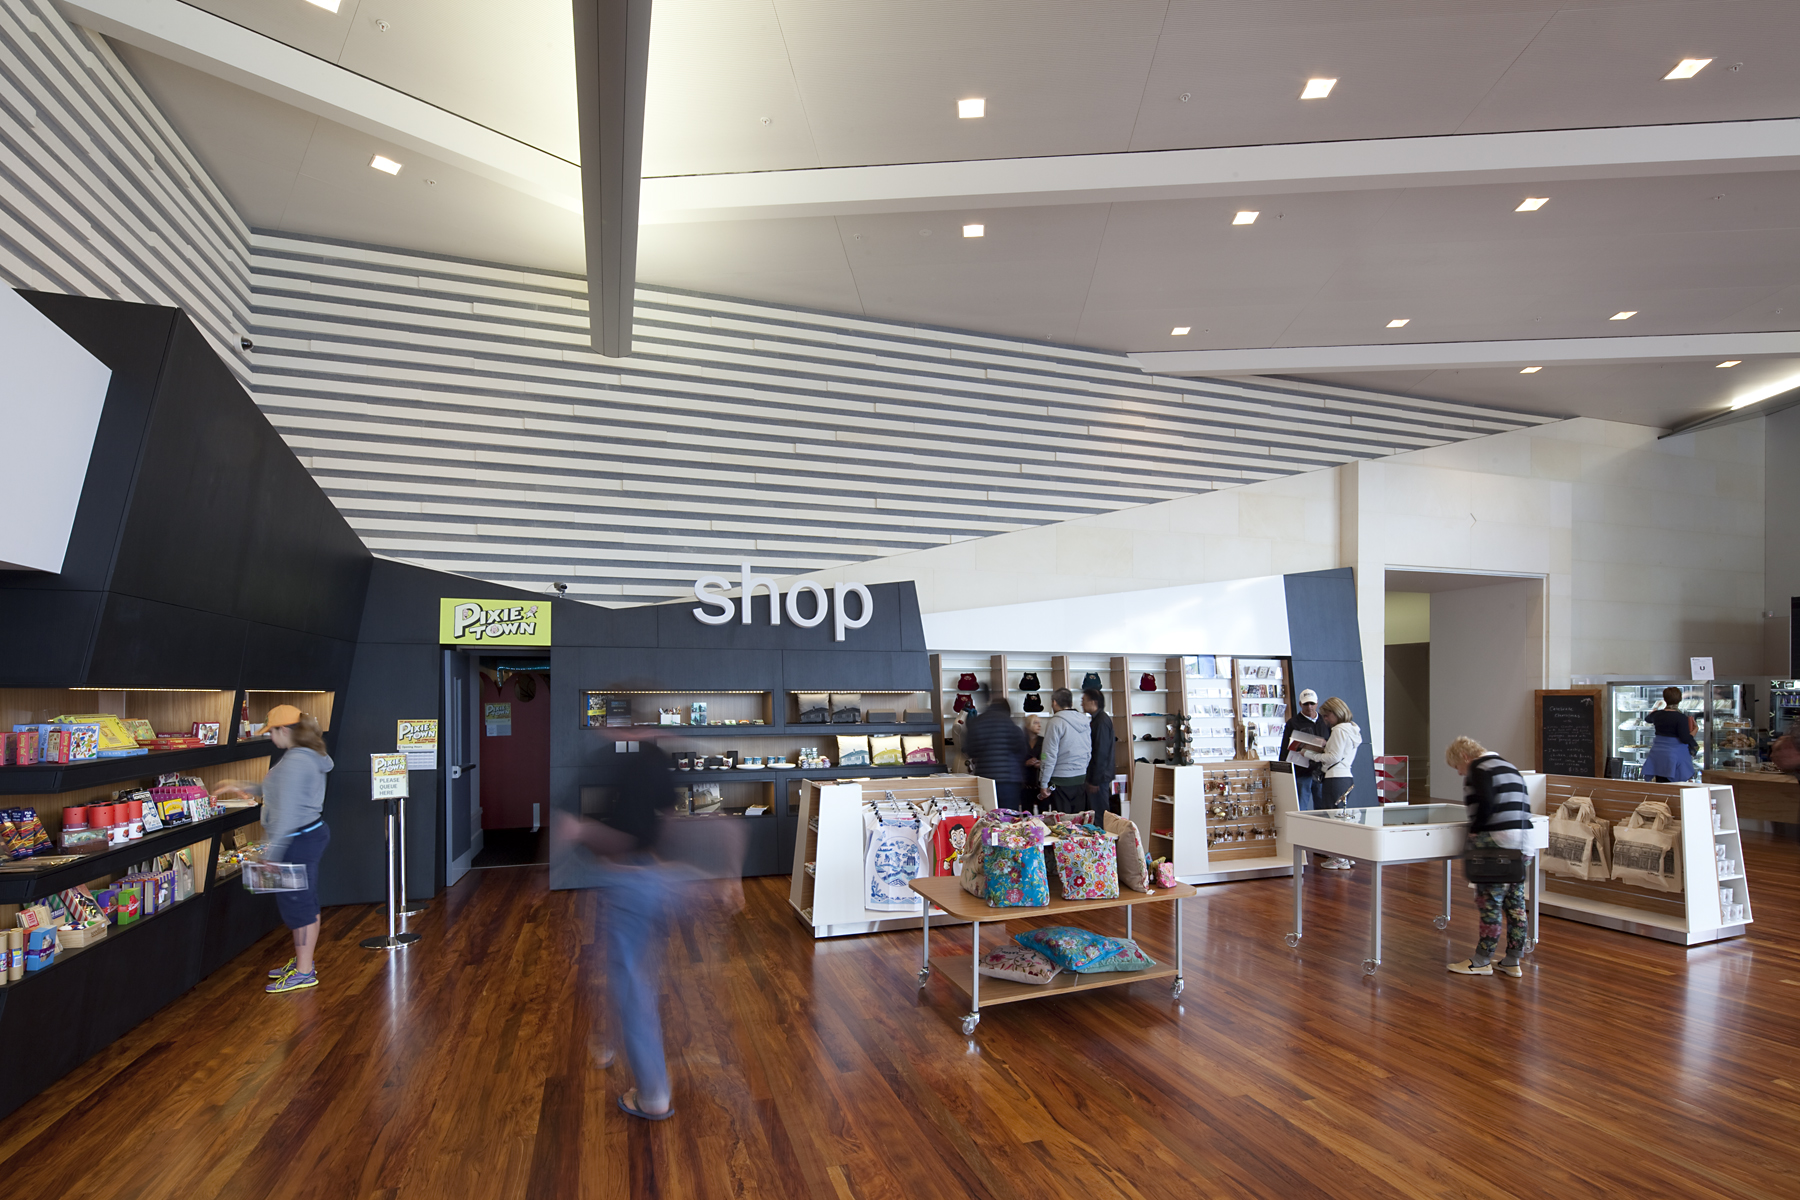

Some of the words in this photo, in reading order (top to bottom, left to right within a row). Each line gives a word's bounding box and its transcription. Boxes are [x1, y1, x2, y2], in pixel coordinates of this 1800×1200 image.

[692, 561, 874, 643] shop
[453, 603, 524, 639] PIXIE
[469, 622, 537, 640] TOWN
[399, 722, 431, 741] PIXIE
[406, 730, 436, 741] TOWN
[374, 757, 401, 774] PIXIE
[380, 763, 405, 774] TOWN
